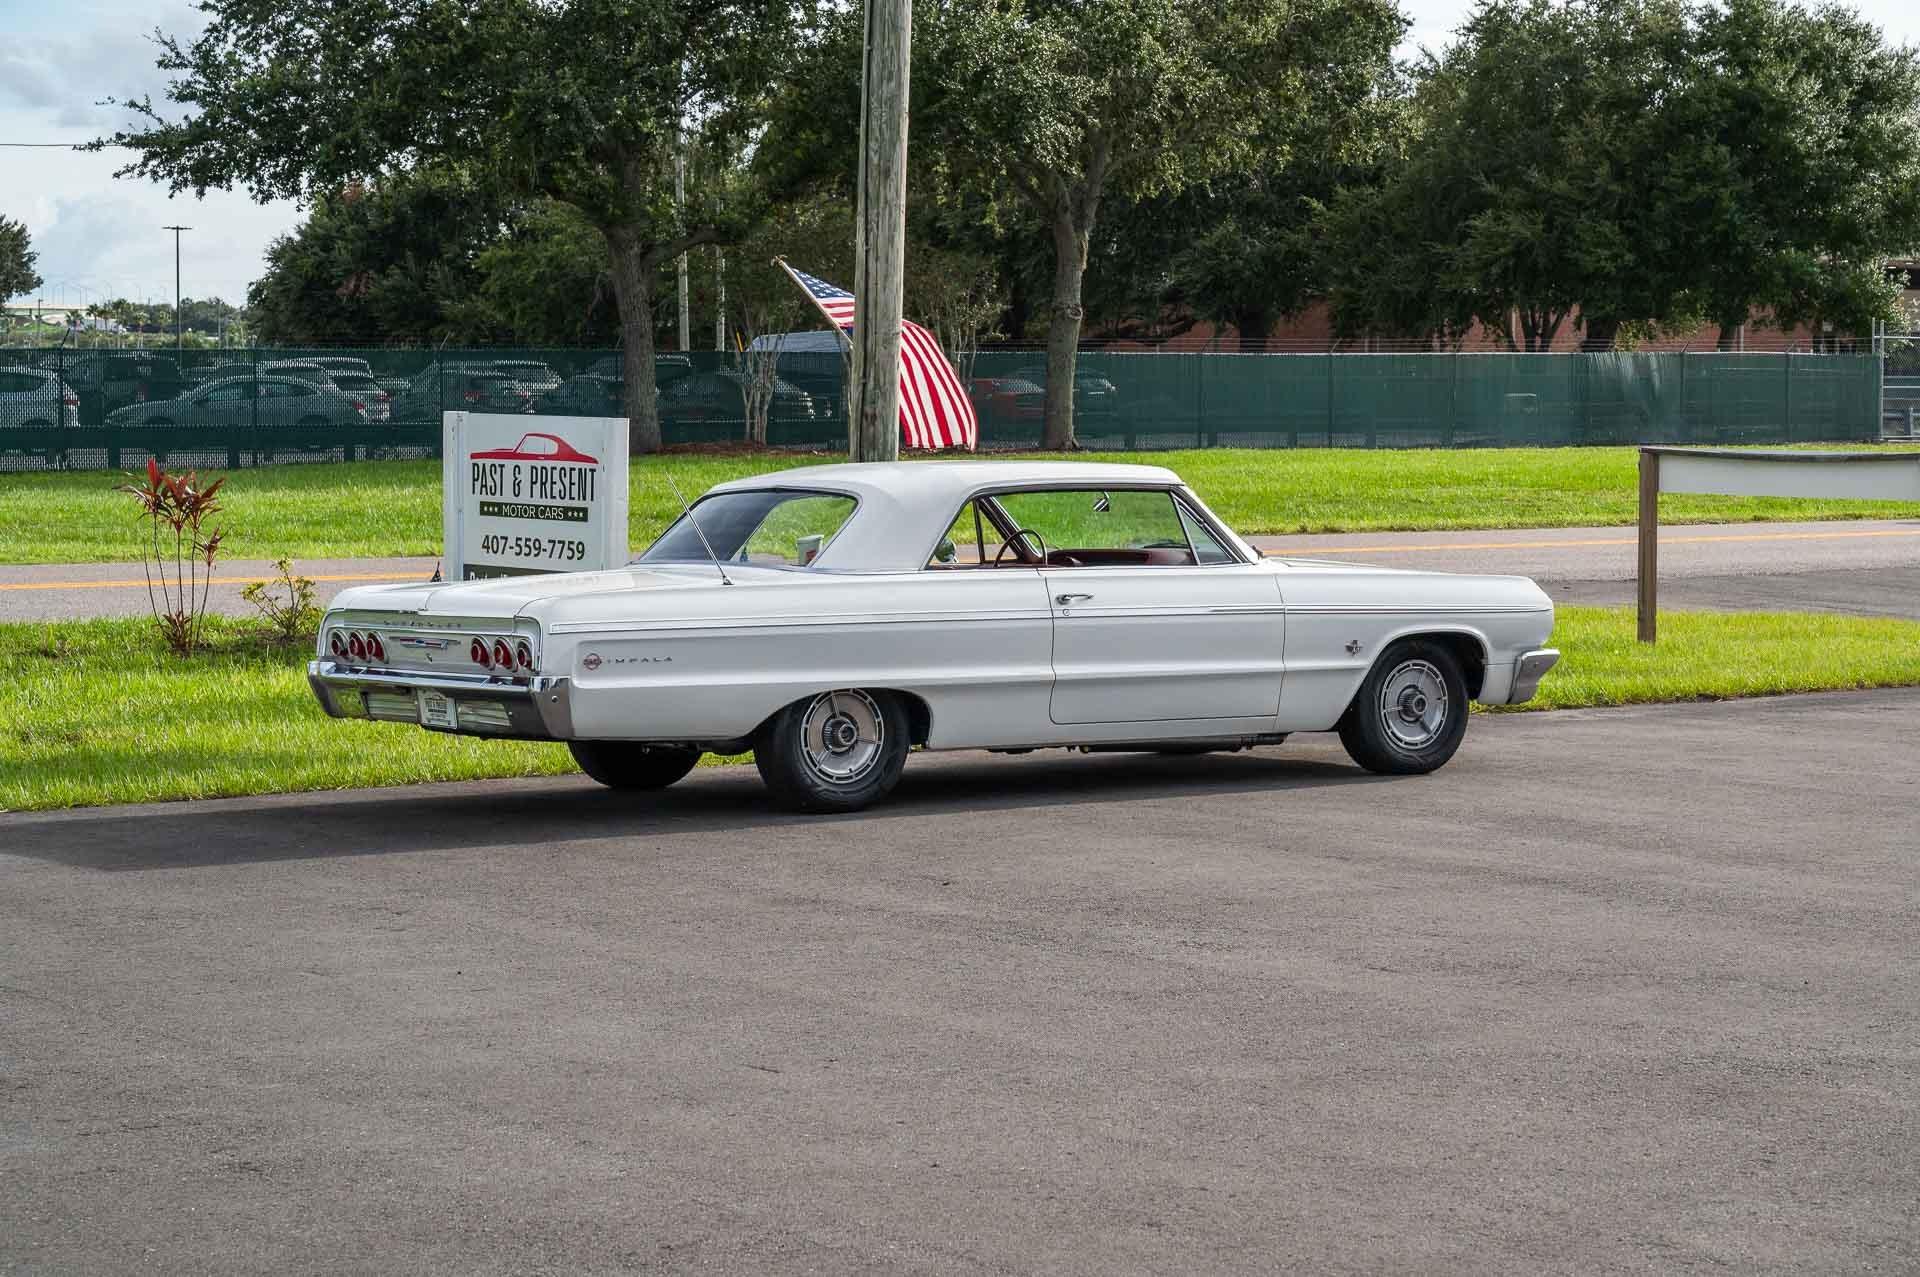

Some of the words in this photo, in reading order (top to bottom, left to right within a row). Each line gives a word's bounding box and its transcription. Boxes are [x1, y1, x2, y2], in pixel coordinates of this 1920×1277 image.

[472, 463, 505, 496] PAST
[513, 465, 522, 498] &
[530, 465, 597, 502] PRESENT
[502, 505, 536, 519] MOTOR
[538, 506, 564, 520] CARS
[481, 534, 585, 561] 407-559-7759
[607, 655, 673, 664] IMPALA
